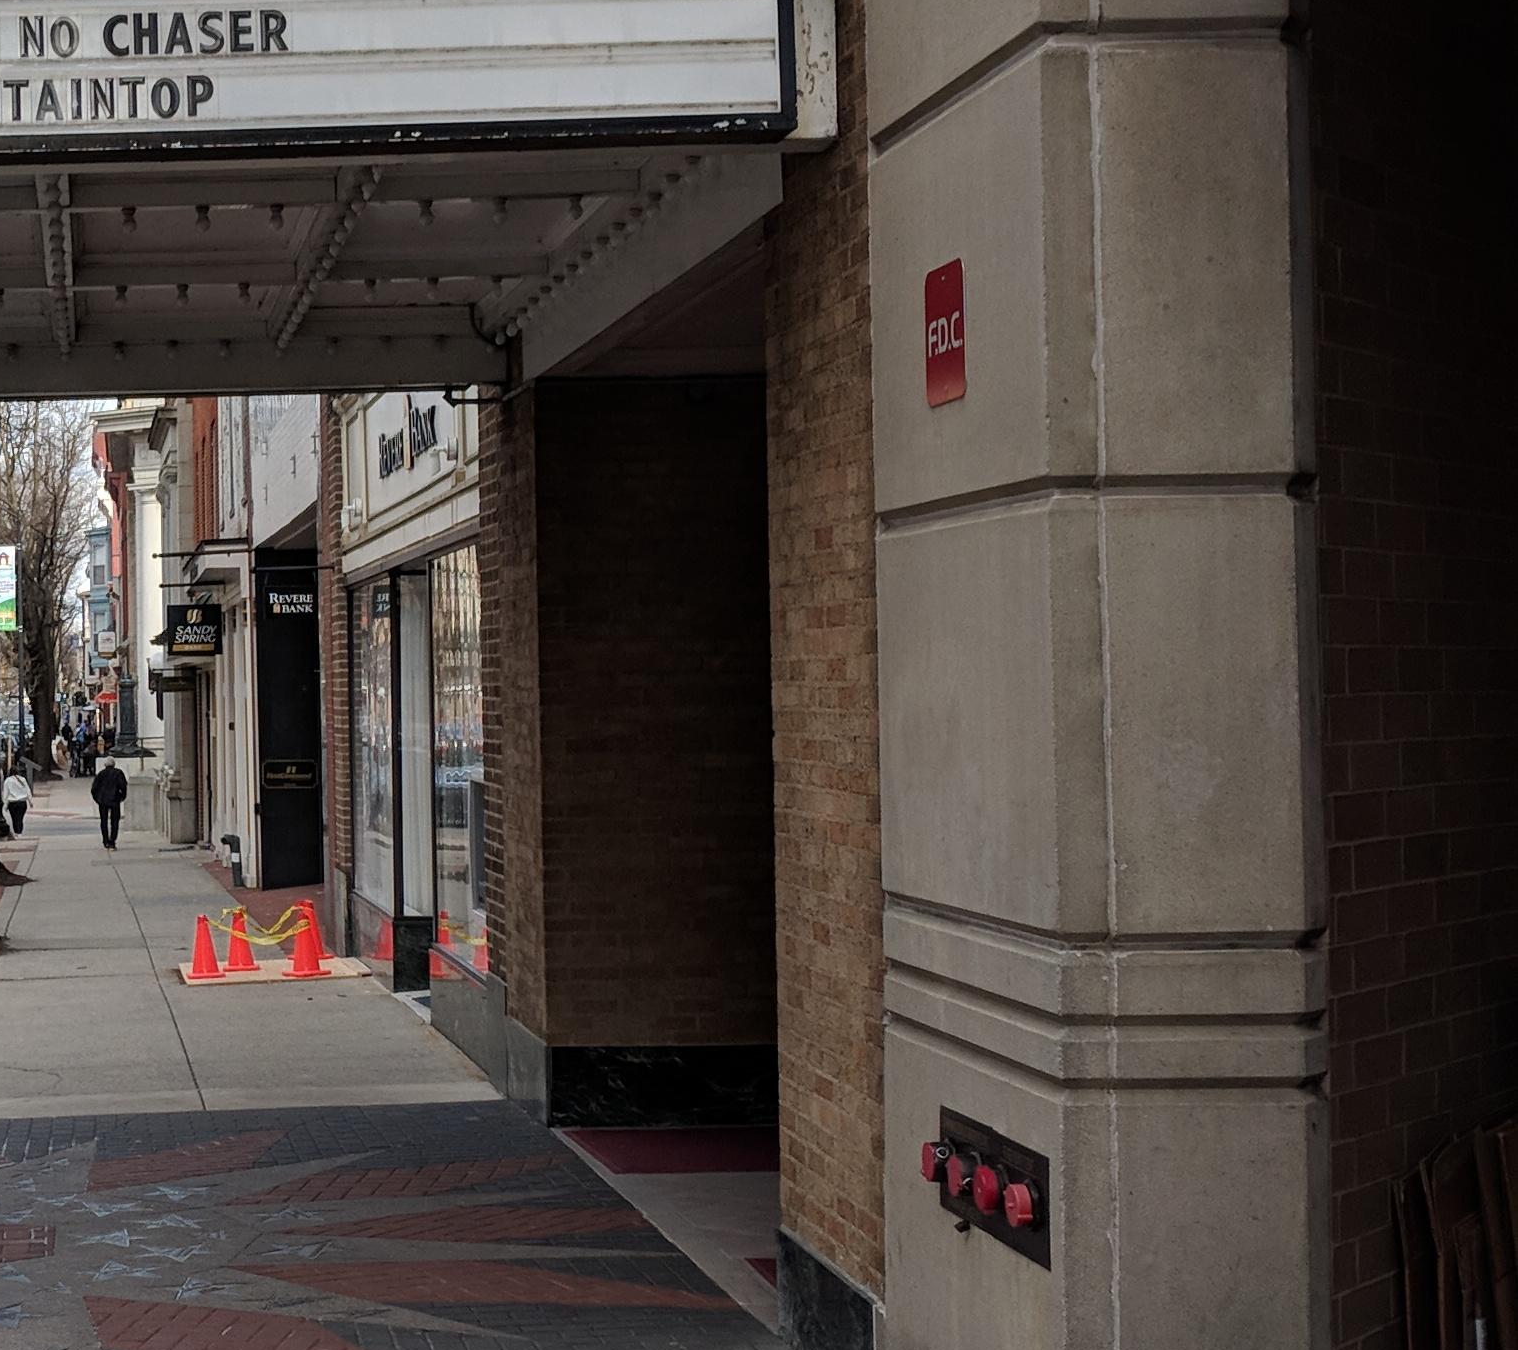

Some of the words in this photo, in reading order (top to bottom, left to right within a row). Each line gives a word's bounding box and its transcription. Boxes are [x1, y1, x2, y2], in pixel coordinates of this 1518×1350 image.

[18, 15, 79, 58] NO
[102, 8, 289, 56] CHASER
[176, 625, 217, 636] SANDY
[174, 634, 216, 644] SPRING
